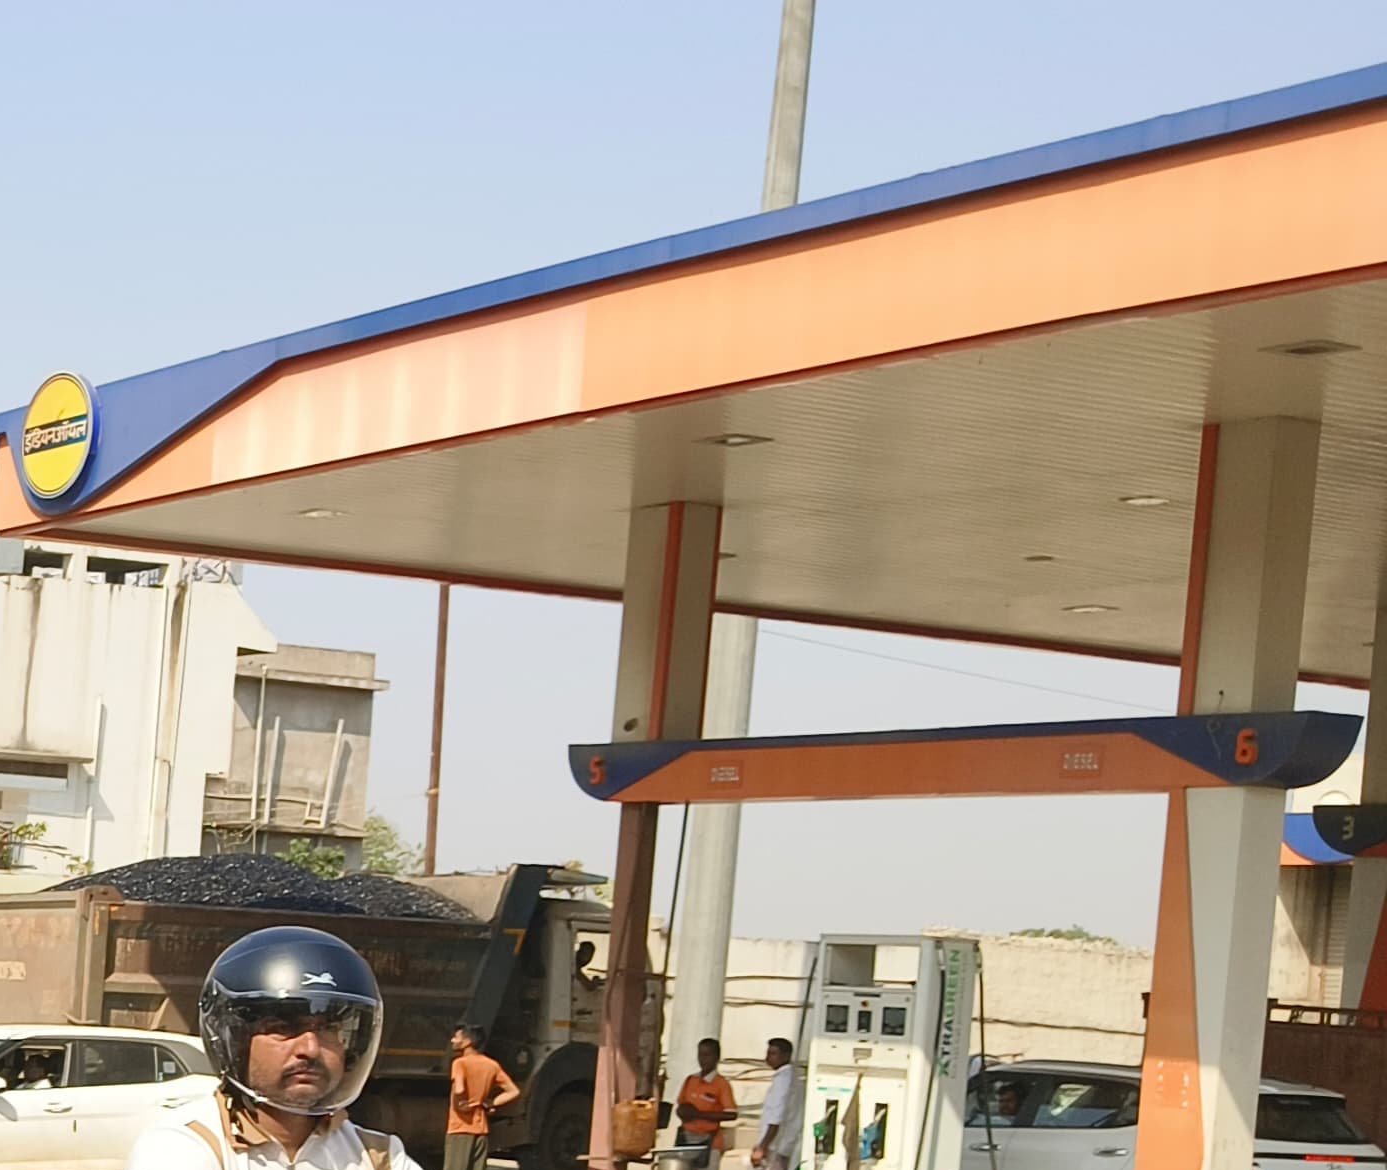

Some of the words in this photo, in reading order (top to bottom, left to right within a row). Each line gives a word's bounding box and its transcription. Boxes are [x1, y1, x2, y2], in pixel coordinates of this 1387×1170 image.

[24, 420, 87, 454] इंडियनऑयल
[1234, 728, 1258, 766] 6
[588, 756, 606, 785] 5
